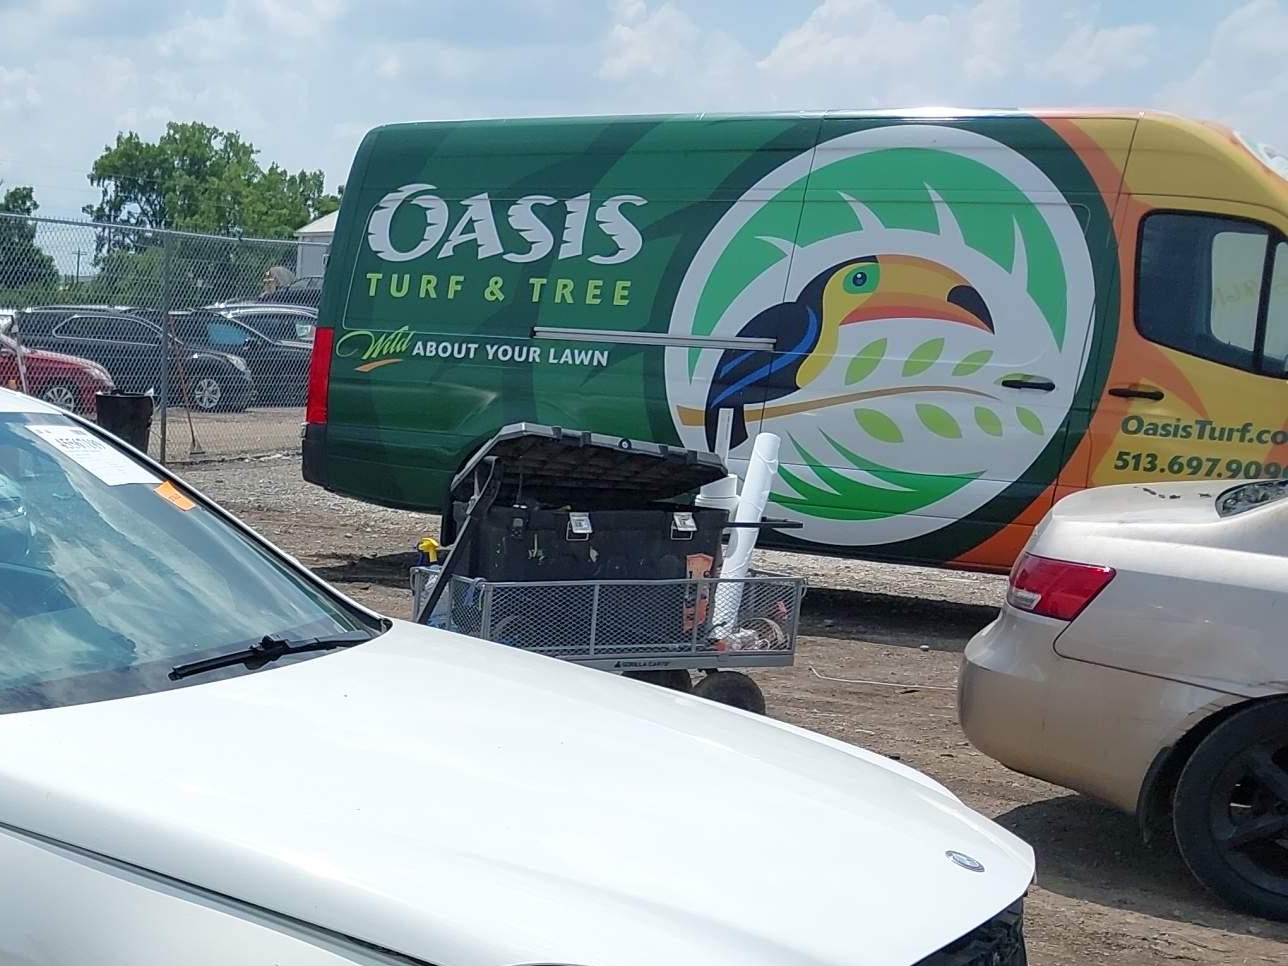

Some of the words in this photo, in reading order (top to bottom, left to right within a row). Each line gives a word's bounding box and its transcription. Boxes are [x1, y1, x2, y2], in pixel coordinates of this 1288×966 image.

[367, 183, 649, 265] OASIS
[366, 273, 465, 300] TURF
[484, 276, 505, 302] &
[528, 278, 632, 306] TREE
[335, 325, 416, 360] Wild
[412, 340, 479, 360] ABOUT
[485, 344, 541, 363] YOUR
[548, 347, 609, 367] LAWN
